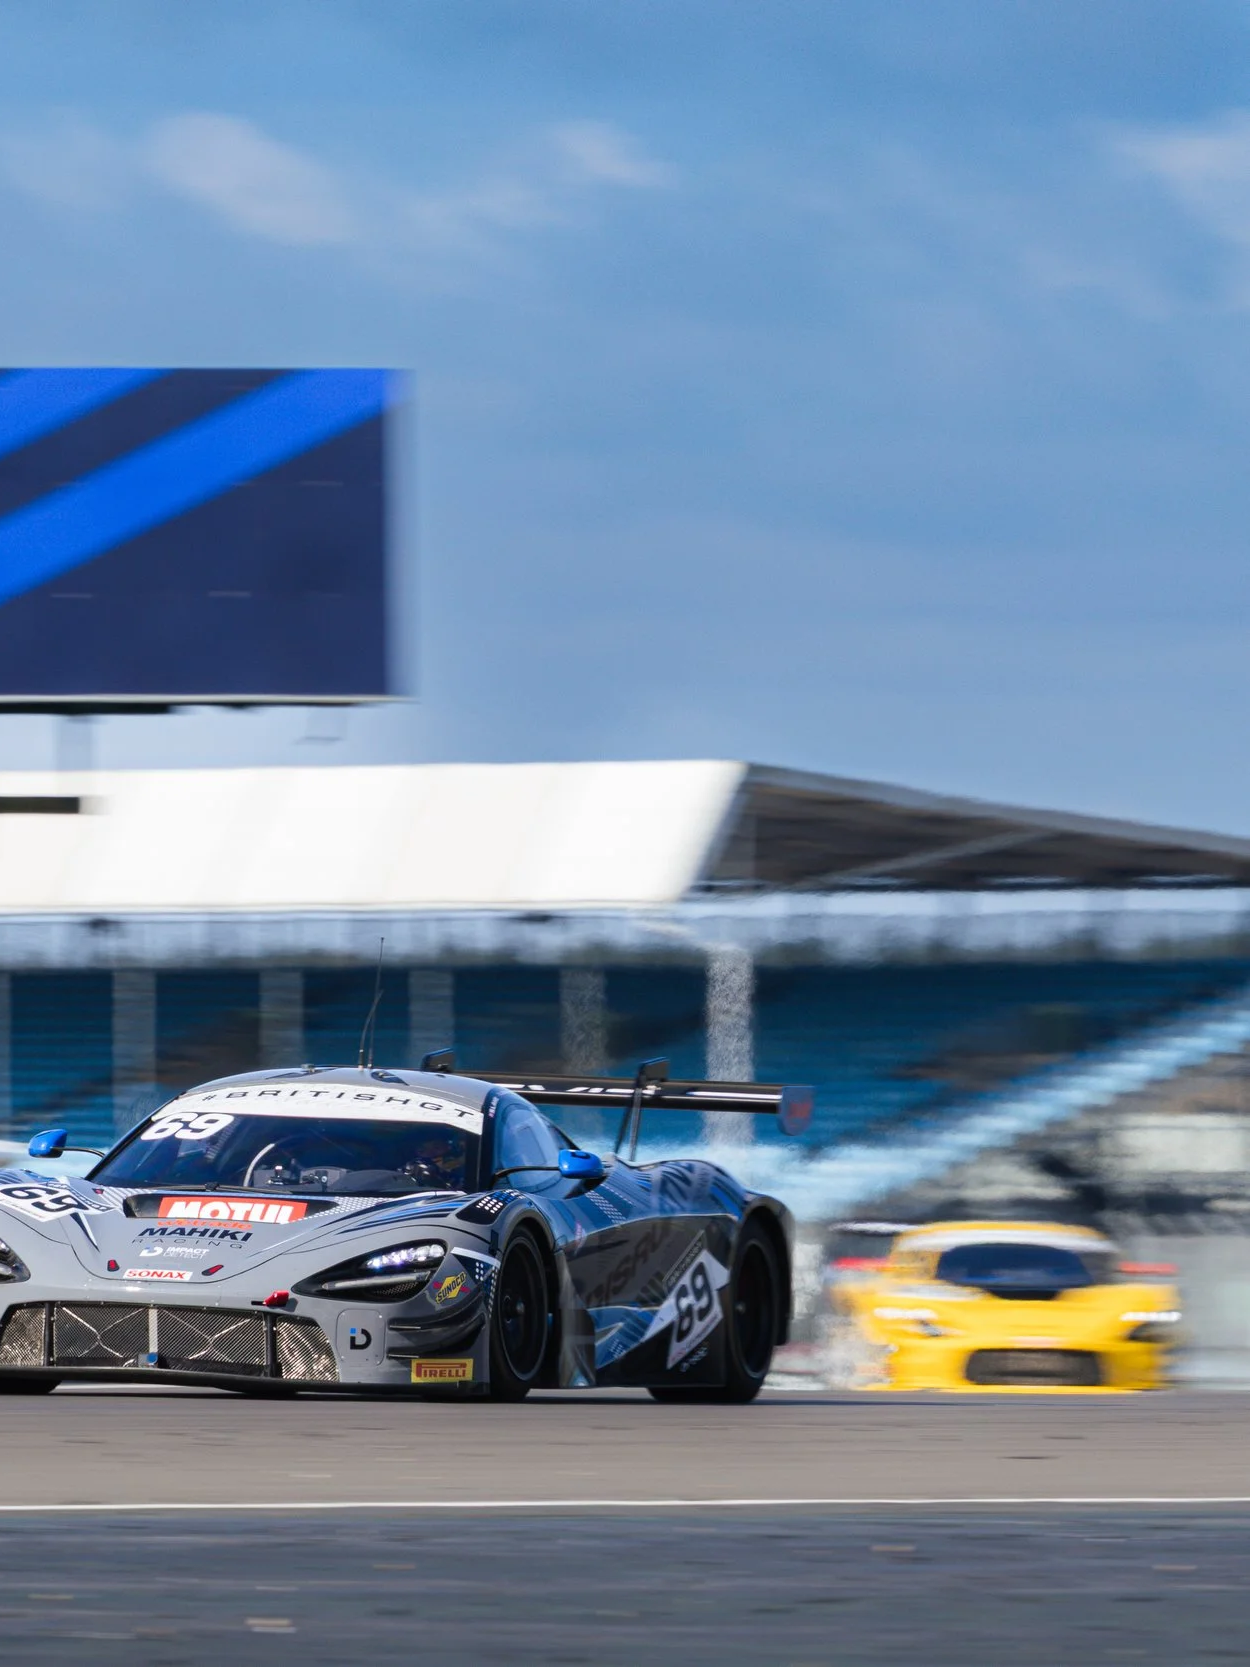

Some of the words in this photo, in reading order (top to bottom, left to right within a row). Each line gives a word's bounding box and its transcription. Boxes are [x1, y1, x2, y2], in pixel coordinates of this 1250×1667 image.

[201, 1089, 474, 1118] #BRITISHGT
[140, 1111, 235, 1140] 69
[0, 1186, 89, 1213] 69
[166, 1201, 295, 1224] MOTUL
[131, 1238, 244, 1250] RACING
[138, 1227, 253, 1242] MAHIKI
[165, 1246, 210, 1256] IMPACT
[126, 1270, 187, 1280] SONAX
[437, 1273, 466, 1301] SUNOCO
[676, 1261, 714, 1343] 69
[415, 1362, 468, 1378] PIRELLI
